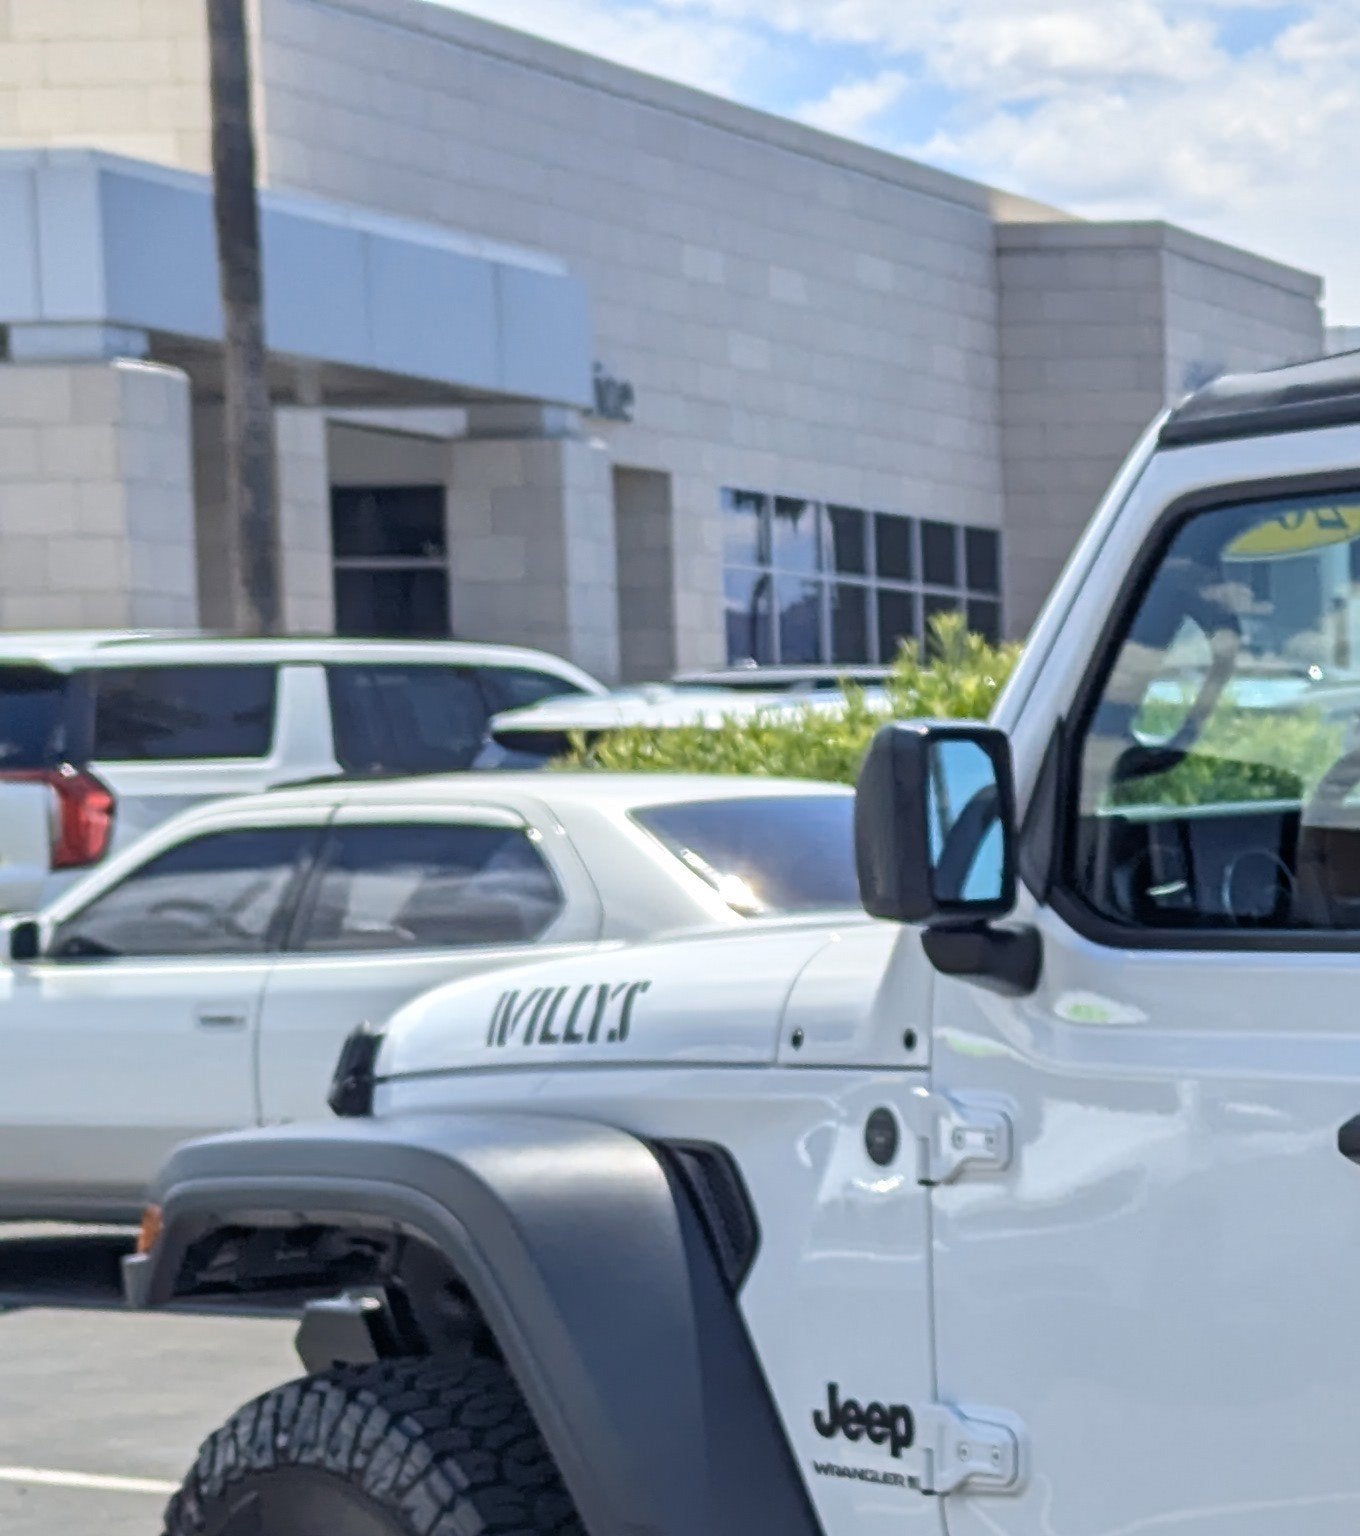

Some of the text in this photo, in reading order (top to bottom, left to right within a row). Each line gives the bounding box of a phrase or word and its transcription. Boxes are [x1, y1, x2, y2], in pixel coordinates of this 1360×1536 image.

[486, 980, 653, 1048] WILLYS
[812, 1381, 916, 1459] Jeep
[812, 1460, 907, 1488] WRANGLER
